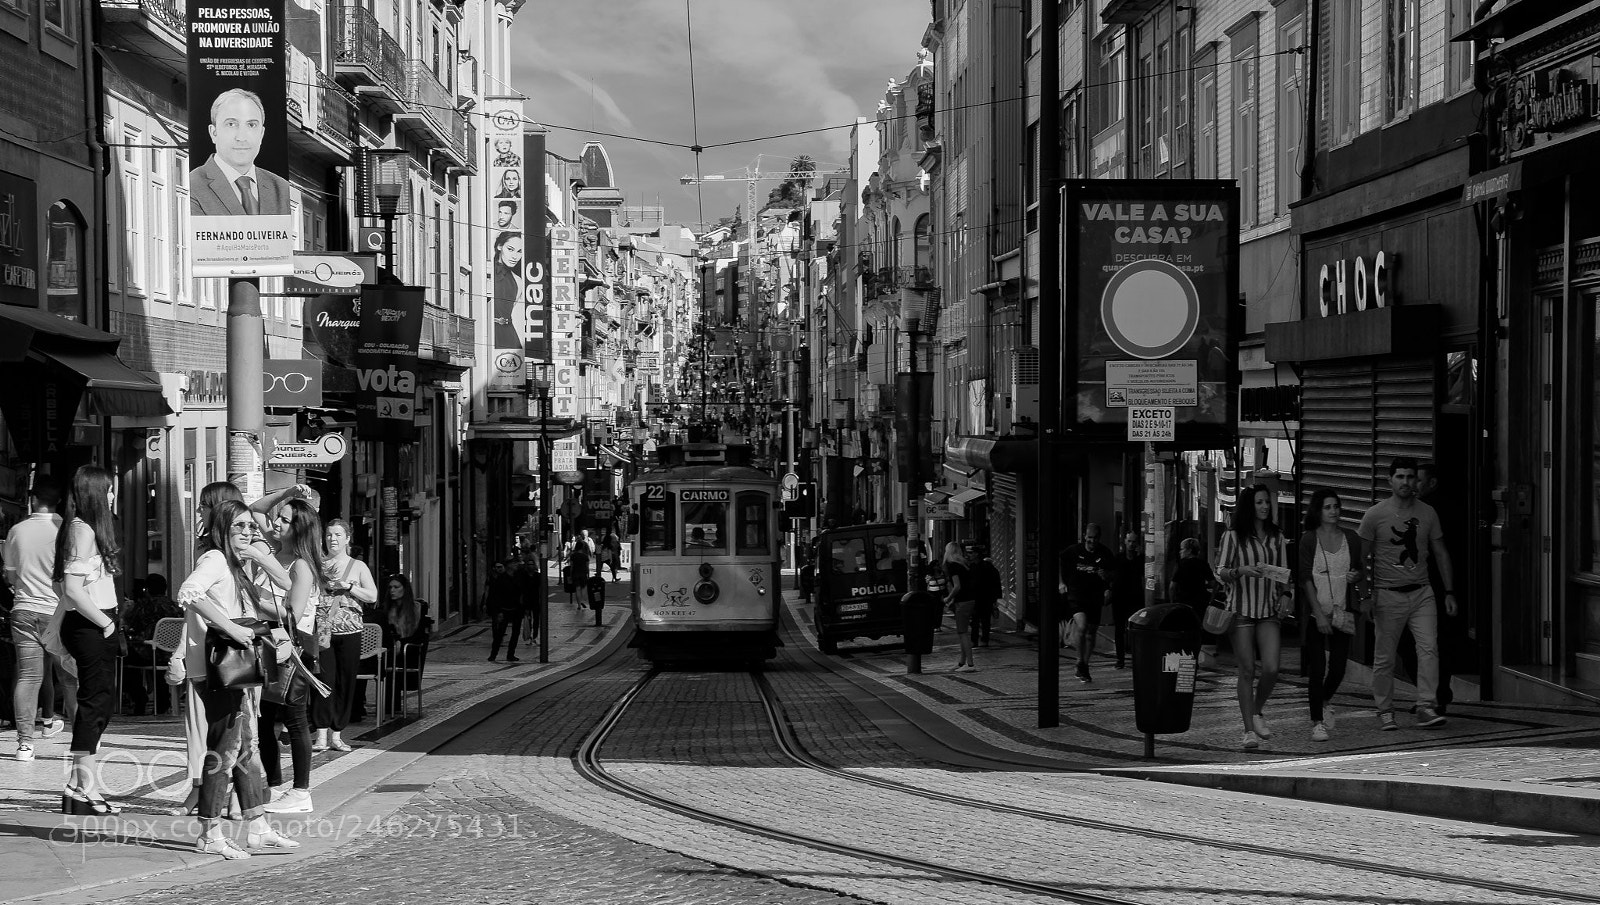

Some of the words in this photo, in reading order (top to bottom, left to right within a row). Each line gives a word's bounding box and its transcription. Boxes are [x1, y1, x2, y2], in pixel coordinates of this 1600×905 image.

[198, 8, 228, 19] PELAS
[229, 8, 273, 20] PESSOAS,
[191, 22, 242, 33] PROMOVER
[243, 23, 251, 34] A
[252, 20, 280, 33] UNIÃO
[199, 37, 213, 48] NA
[214, 37, 274, 49] DIVERSIDADE
[1081, 203, 1145, 221] VALE
[1150, 203, 1169, 221] A
[1174, 203, 1225, 222] SUA
[196, 230, 244, 241] FERNANDO
[246, 230, 289, 241] OLIVEIRA
[1114, 226, 1193, 244] CASA?
[1176, 254, 1193, 263] EM
[293, 267, 316, 276] UNES
[1319, 250, 1386, 318] CHOC
[555, 229, 572, 414] PERFECT
[499, 357, 518, 368] C&A
[356, 364, 416, 394] vota
[1127, 398, 1168, 406] BLOQUEAMENTO
[1132, 409, 1172, 419] EXCETO
[1132, 420, 1144, 429] DIAS
[1145, 420, 1149, 429] 2
[647, 484, 664, 499] 22
[681, 490, 728, 501] CARMO
[587, 499, 611, 510] vota
[851, 583, 897, 597] POLÍCIA
